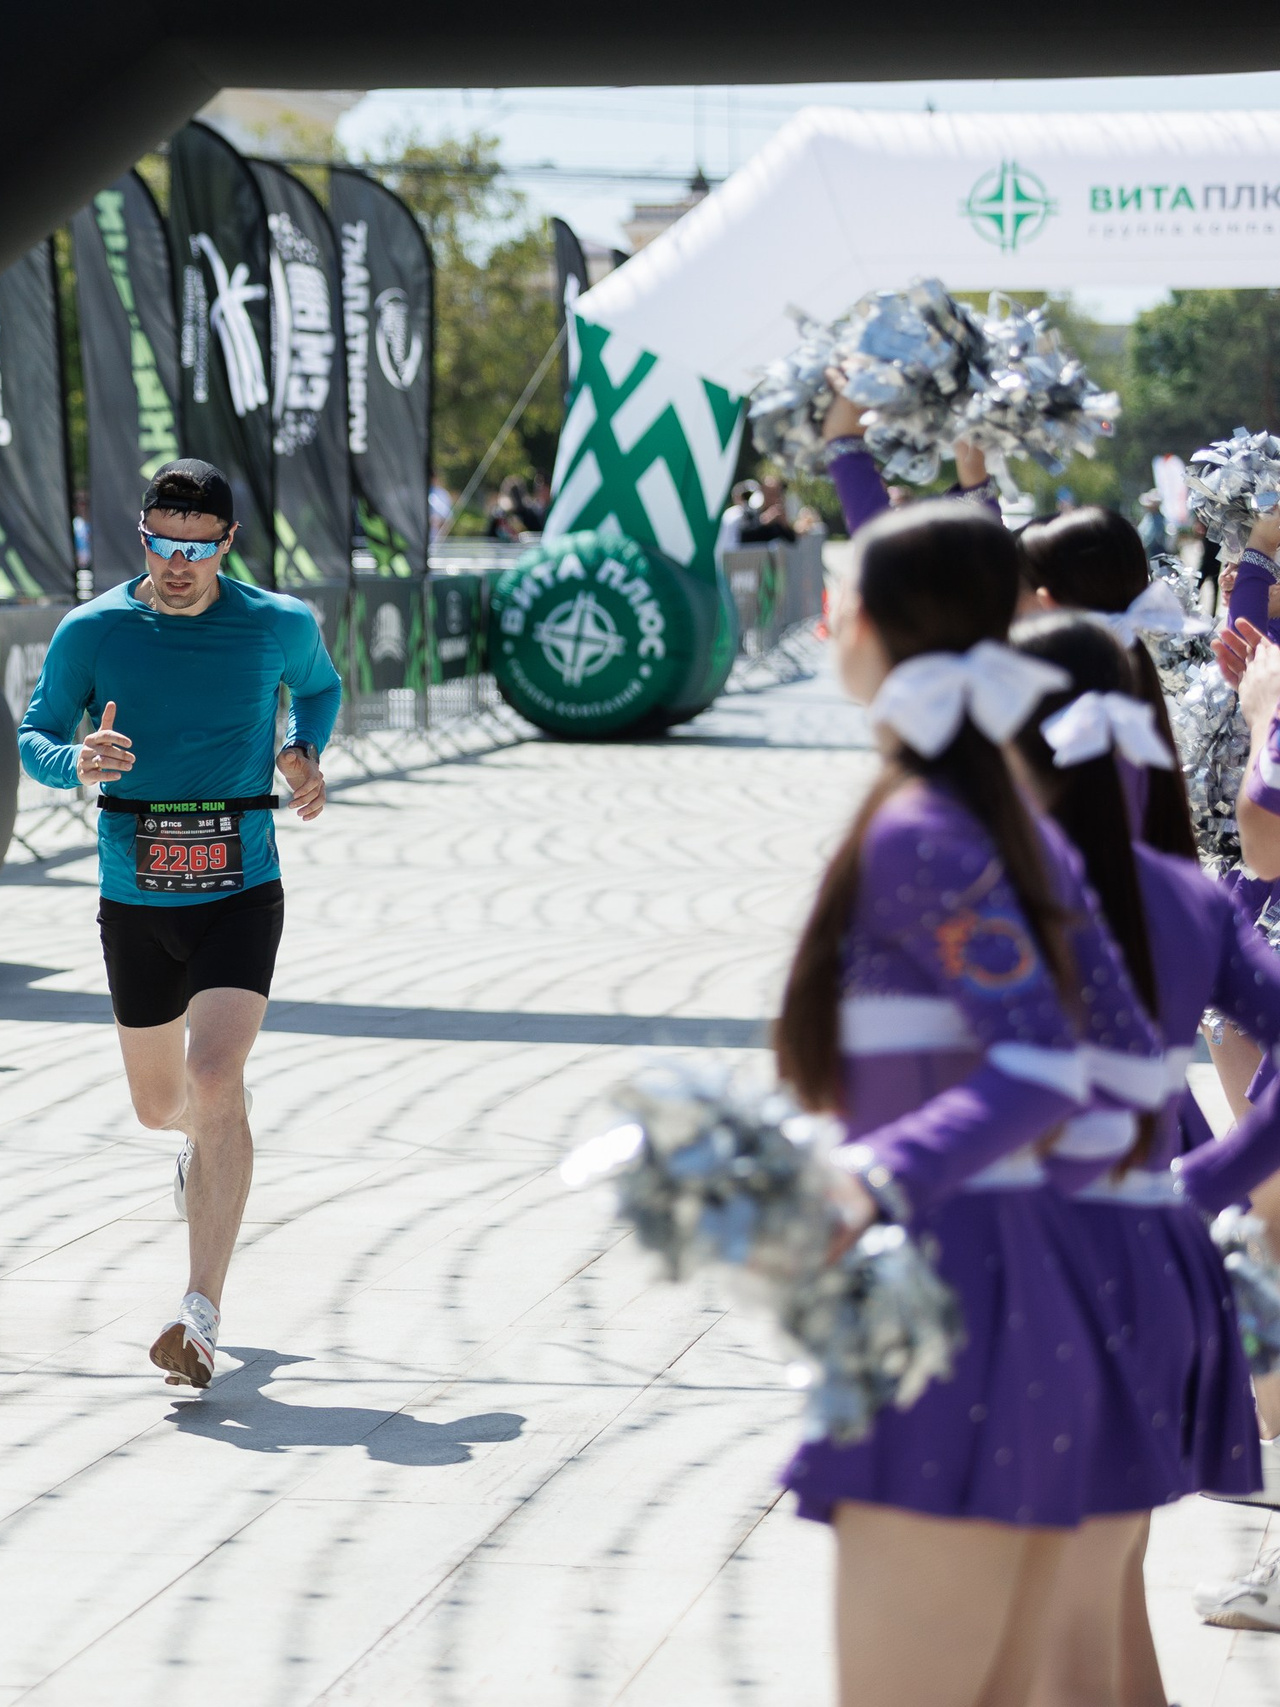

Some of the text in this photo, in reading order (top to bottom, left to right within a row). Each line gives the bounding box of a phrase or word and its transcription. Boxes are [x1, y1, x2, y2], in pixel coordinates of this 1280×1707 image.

[500, 552, 587, 636] ВИТА
[595, 556, 667, 660] ПЛЮС
[149, 842, 227, 872] 2269
